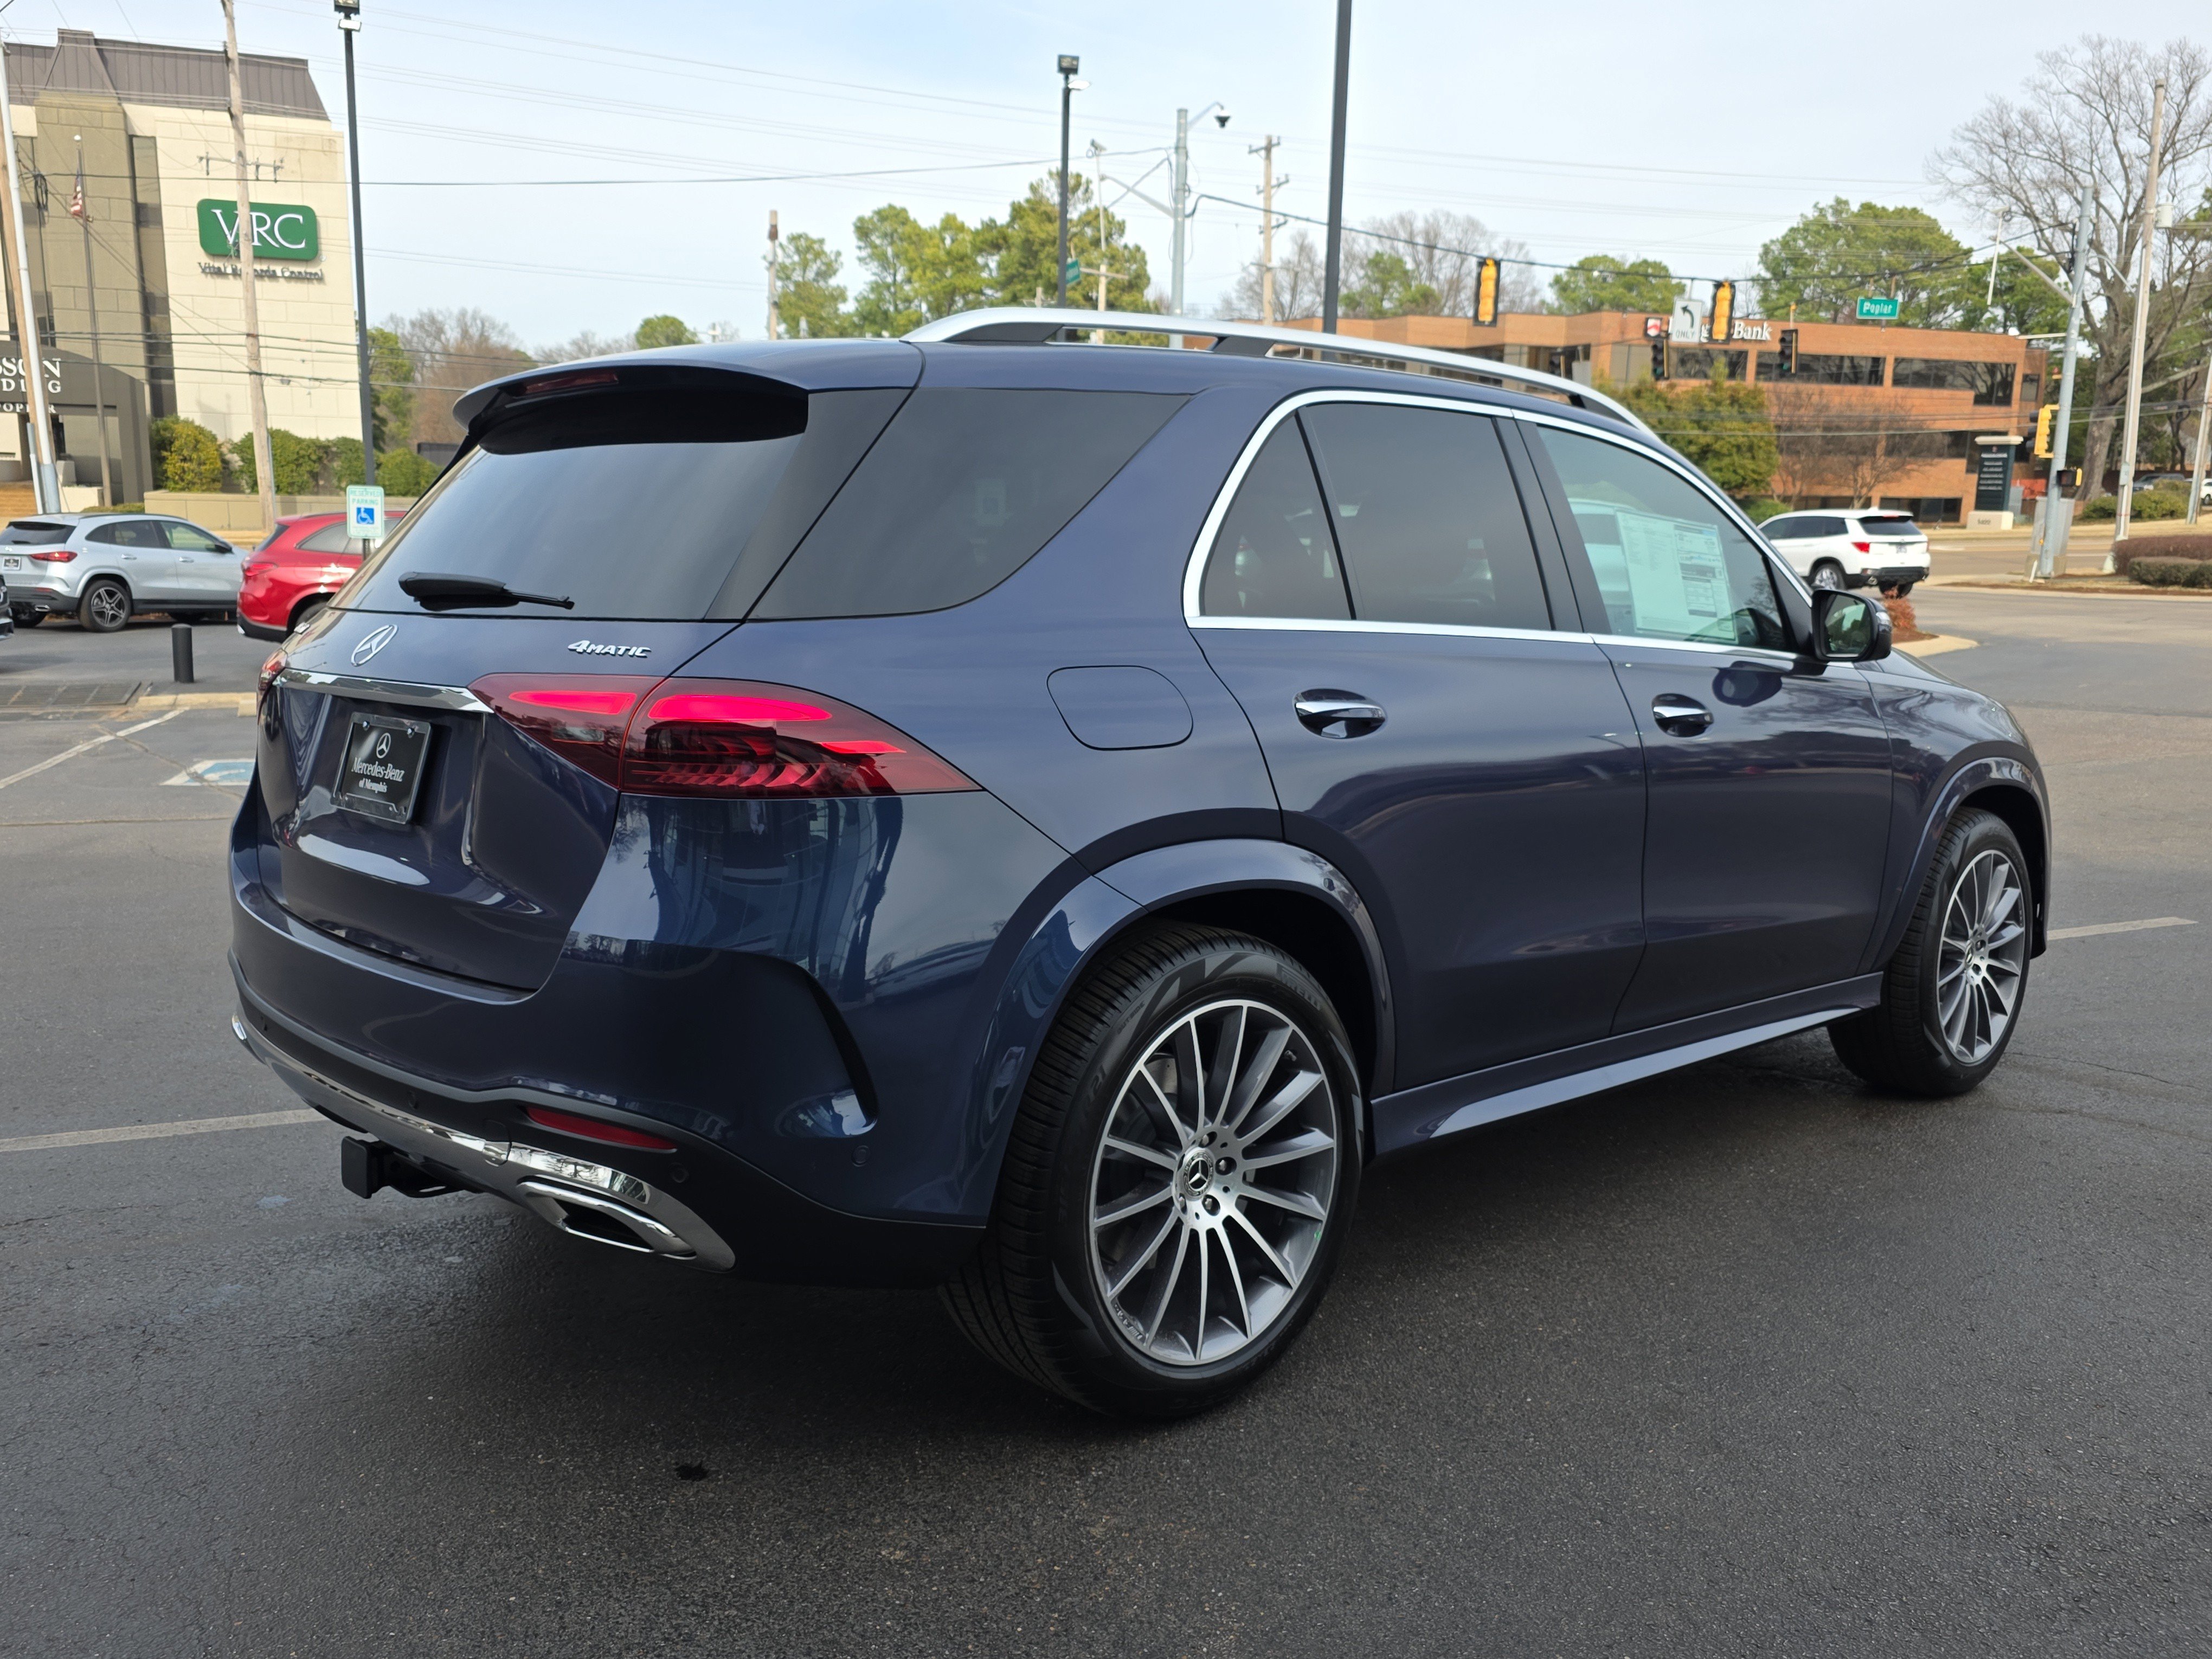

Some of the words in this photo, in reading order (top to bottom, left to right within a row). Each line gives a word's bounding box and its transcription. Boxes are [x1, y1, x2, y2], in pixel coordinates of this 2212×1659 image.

[210, 209, 305, 249] VRC
[1863, 301, 1893, 314] Poplar
[1676, 329, 1695, 339] ONLY
[1732, 320, 1772, 340] Bank
[1, 378, 61, 394] DIG
[568, 640, 652, 658] 4MATIC
[351, 757, 405, 782] Mercedes-Benz
